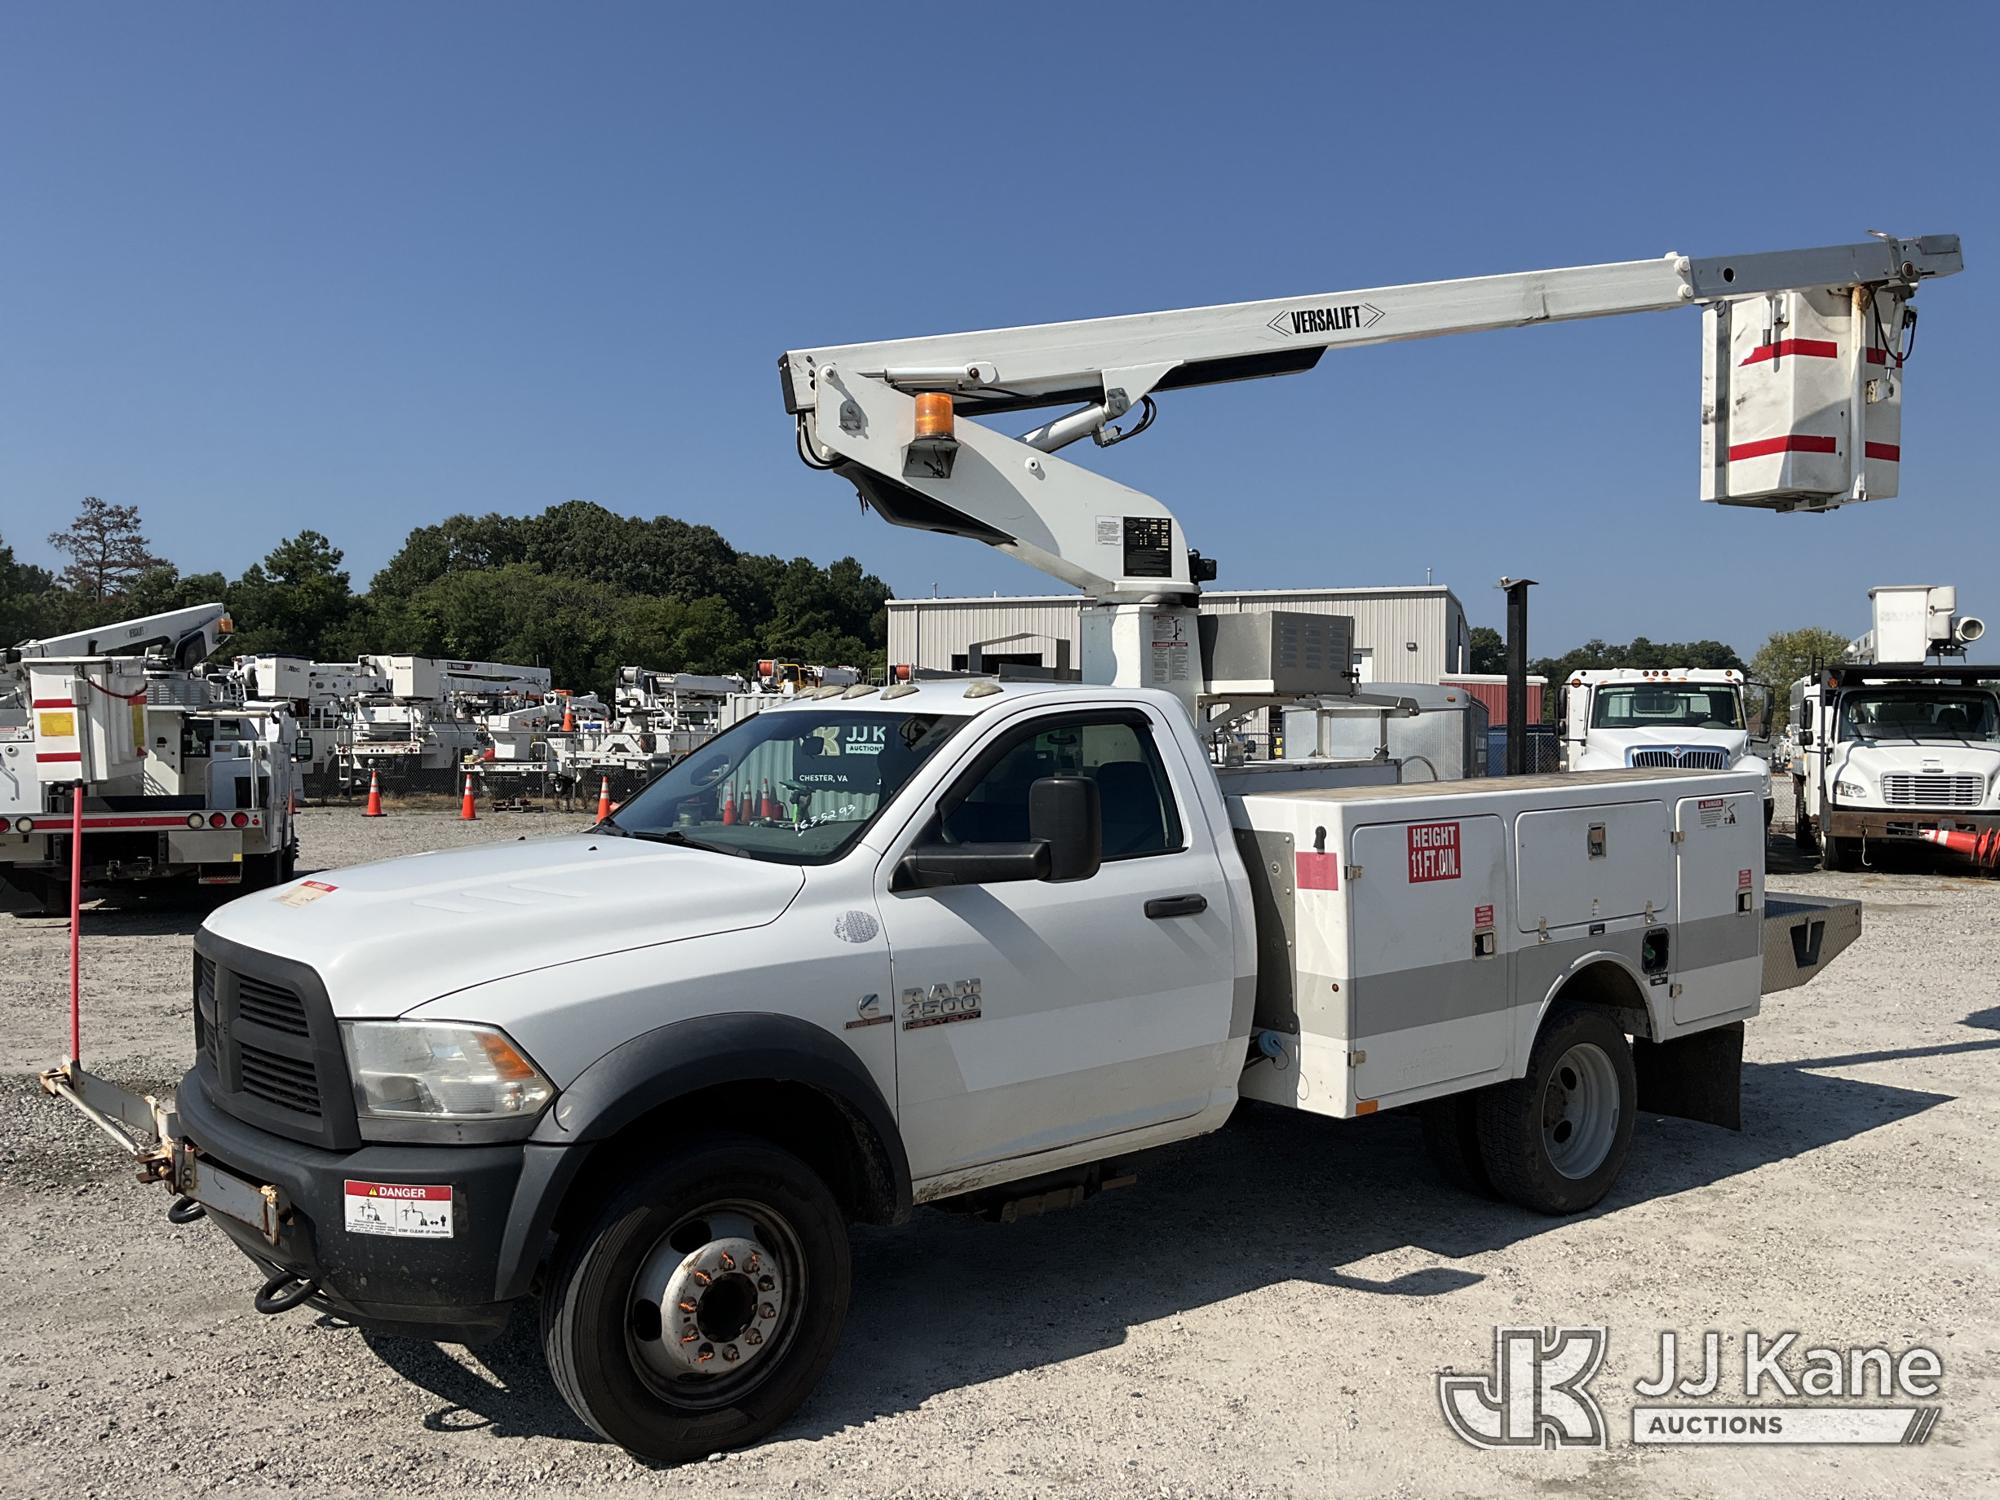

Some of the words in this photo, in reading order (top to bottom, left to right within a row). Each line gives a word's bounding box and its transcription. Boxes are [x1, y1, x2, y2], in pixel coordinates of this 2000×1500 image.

[1291, 306, 1360, 334] VERSALIFT
[799, 774, 836, 784] CHESTER,
[838, 774, 848, 782] VA
[1412, 826, 1456, 848] HEIGHT
[902, 978, 981, 1004] RAM
[902, 994, 982, 1020] 4500
[379, 1186, 426, 1198] DANGER
